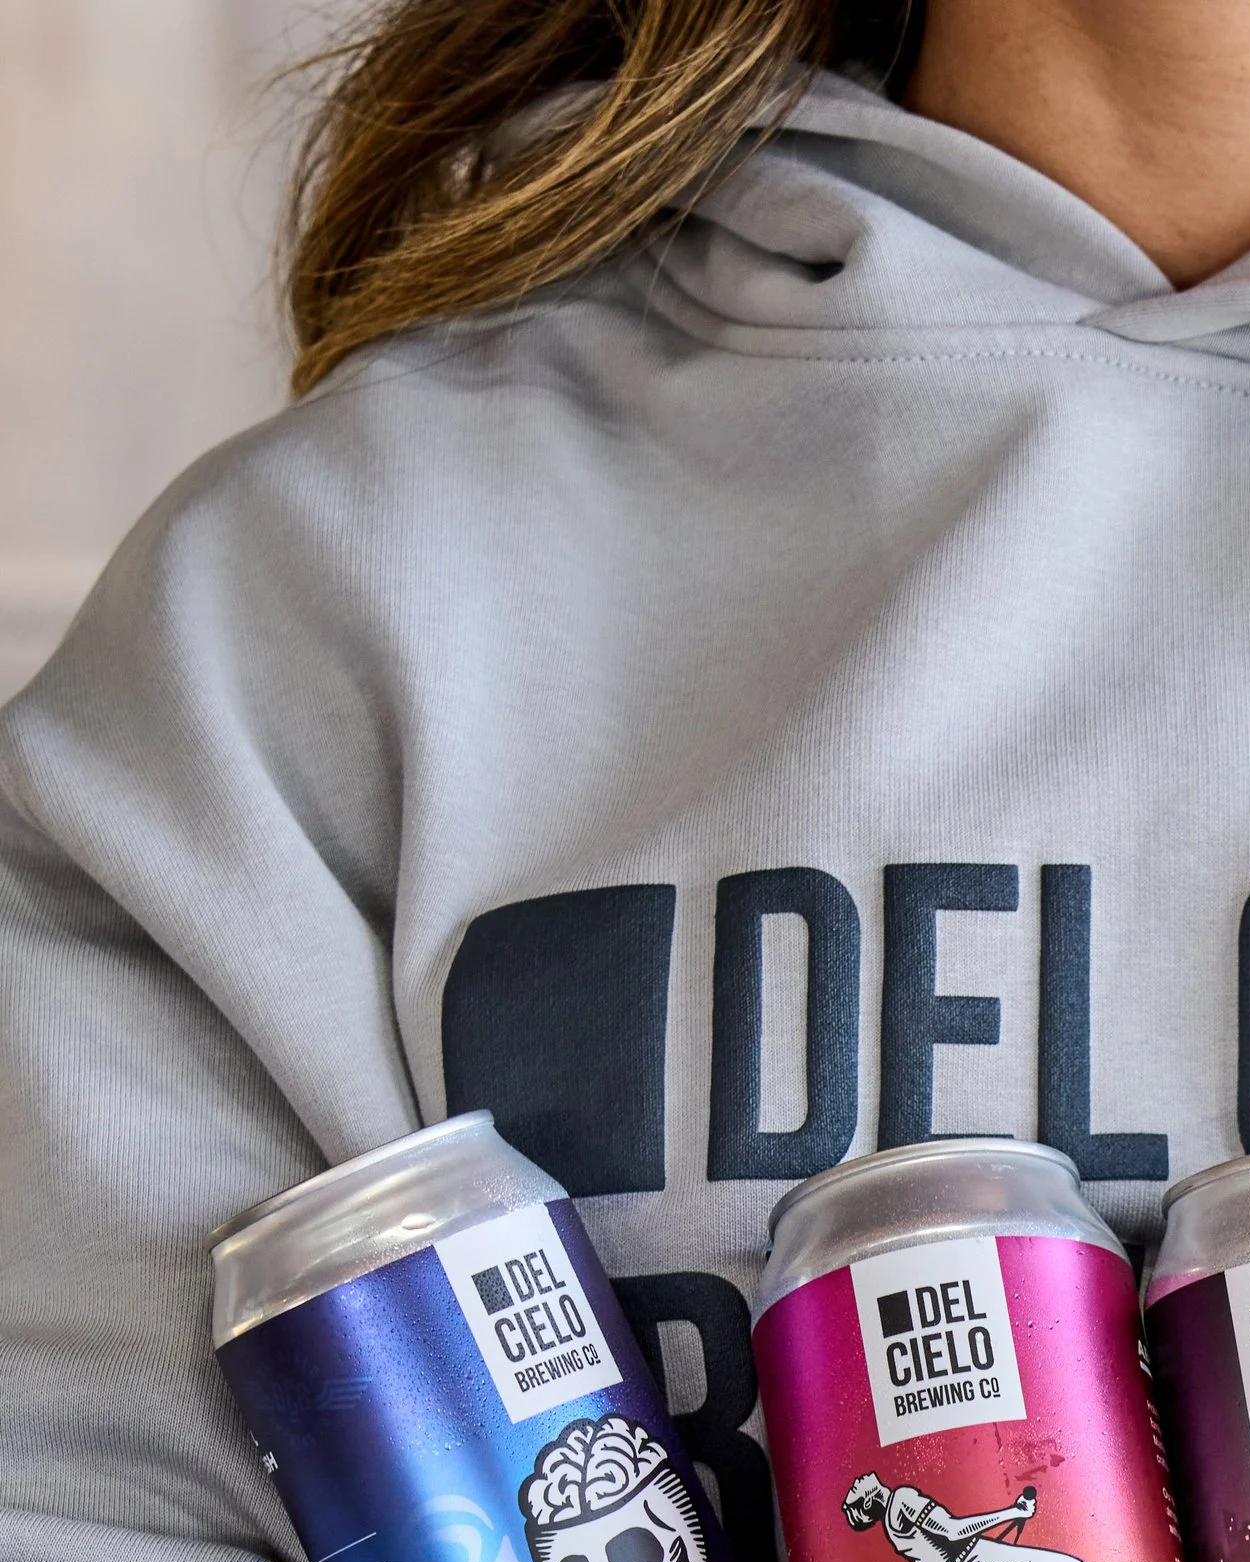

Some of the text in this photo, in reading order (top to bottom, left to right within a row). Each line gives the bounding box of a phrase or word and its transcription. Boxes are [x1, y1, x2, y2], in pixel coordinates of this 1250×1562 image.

[707, 863, 1169, 1184] DEL
[504, 1248, 567, 1302] DEL
[494, 1294, 587, 1363] CIELO
[915, 1279, 987, 1329] DEL
[514, 1349, 584, 1393] BREWING
[886, 1326, 995, 1387] CIELO
[894, 1380, 975, 1417] BREWING
